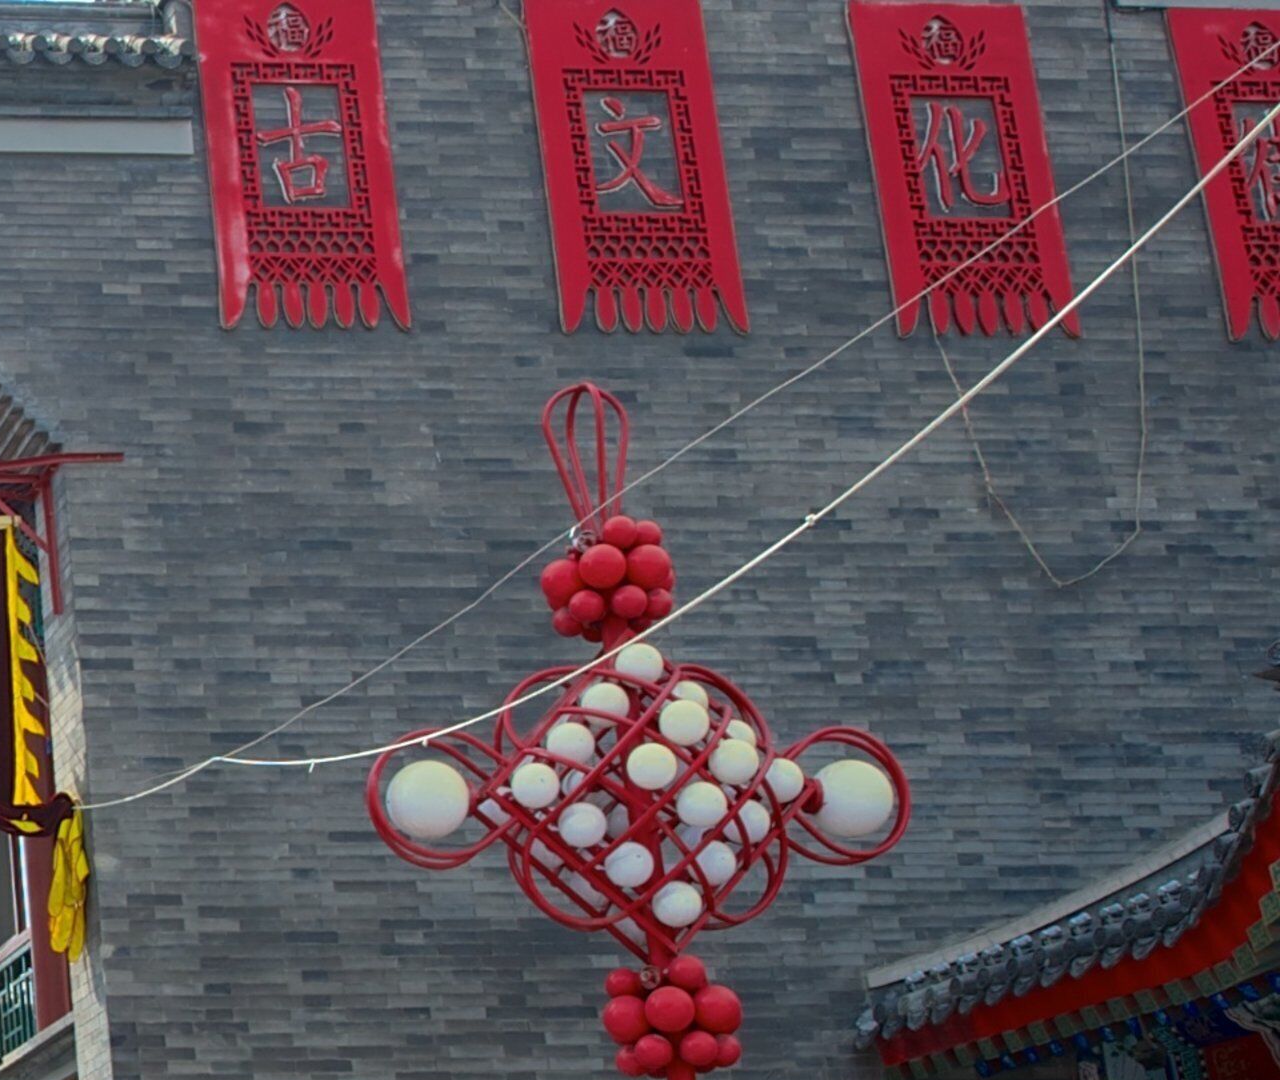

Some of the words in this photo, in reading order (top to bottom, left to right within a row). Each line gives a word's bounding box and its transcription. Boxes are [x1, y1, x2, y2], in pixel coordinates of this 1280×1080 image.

[255, 87, 341, 204] 古
[594, 97, 684, 209] 文
[918, 101, 1012, 213] 化
